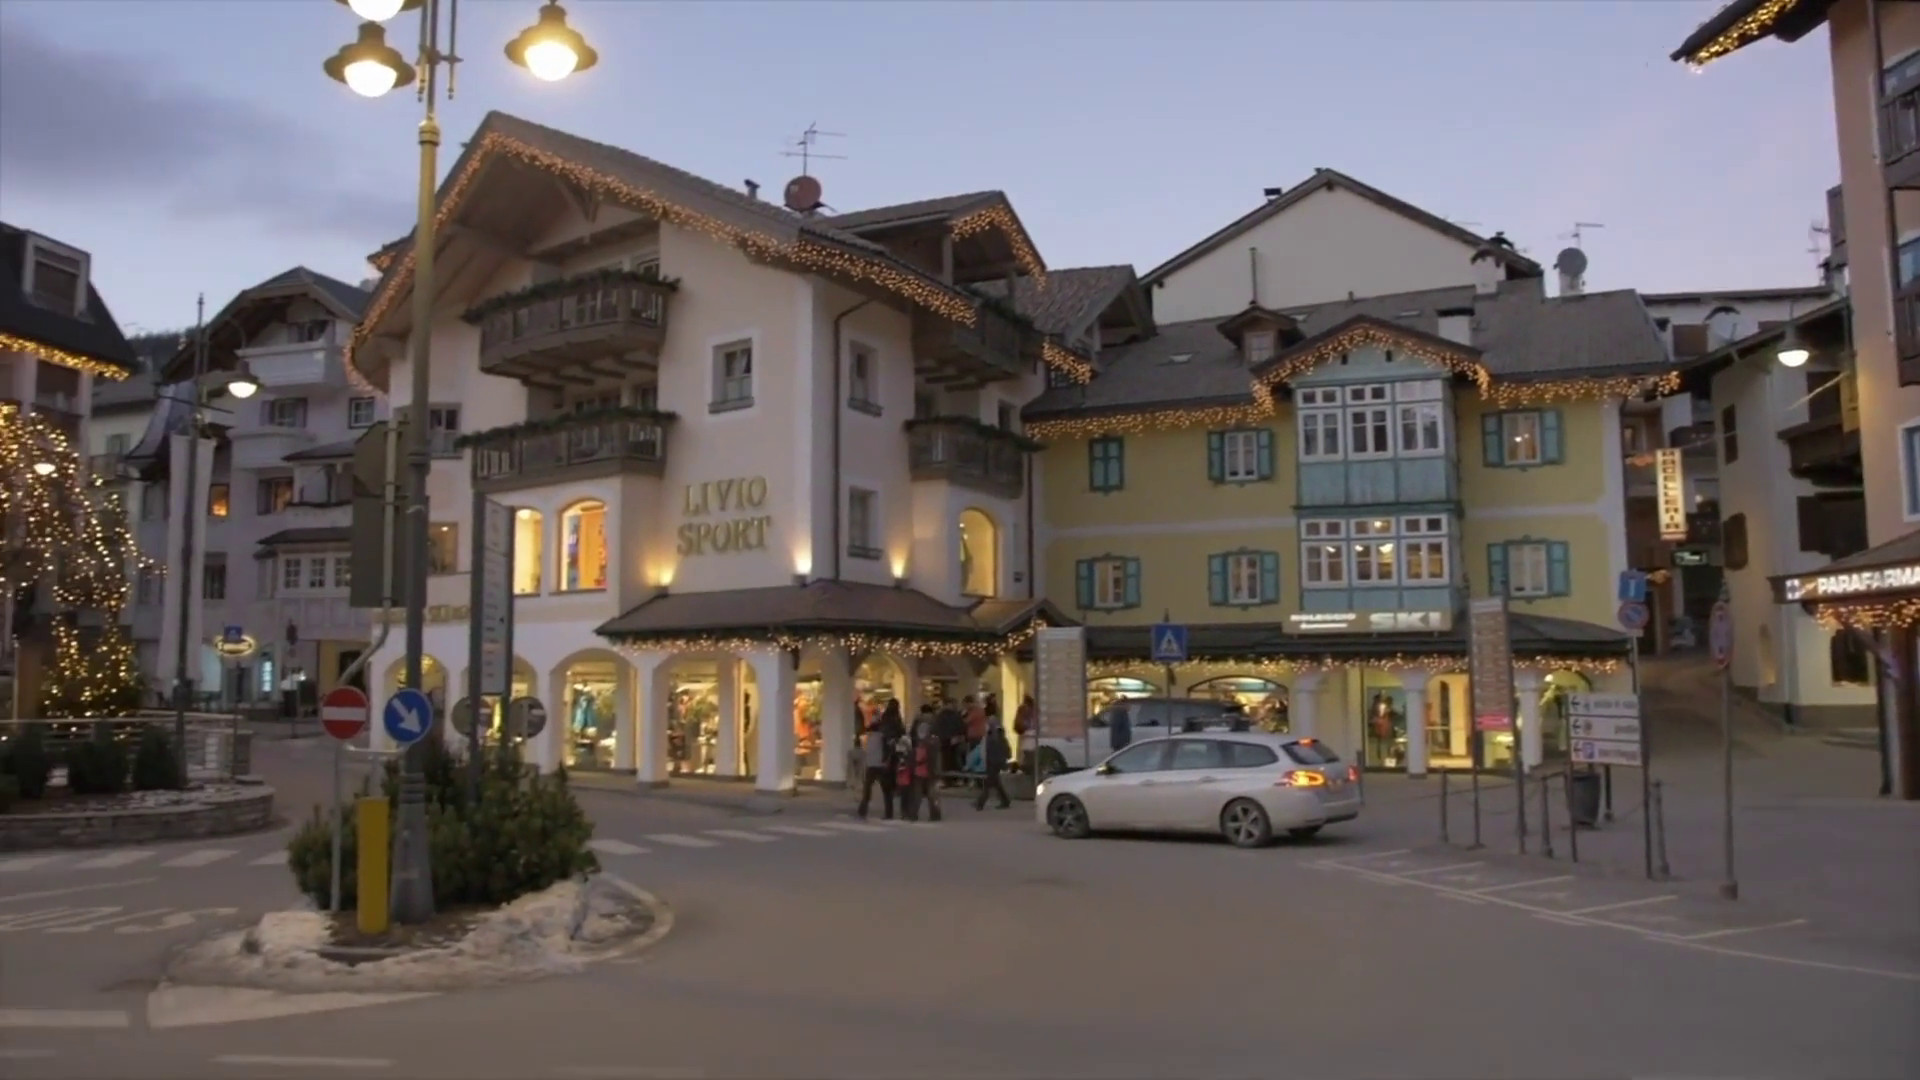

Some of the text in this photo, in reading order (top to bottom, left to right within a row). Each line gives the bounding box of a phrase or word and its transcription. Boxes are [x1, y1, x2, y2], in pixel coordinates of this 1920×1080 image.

[683, 475, 768, 517] LIVIO
[676, 515, 772, 557] SPORT
[1370, 611, 1442, 631] SKI
